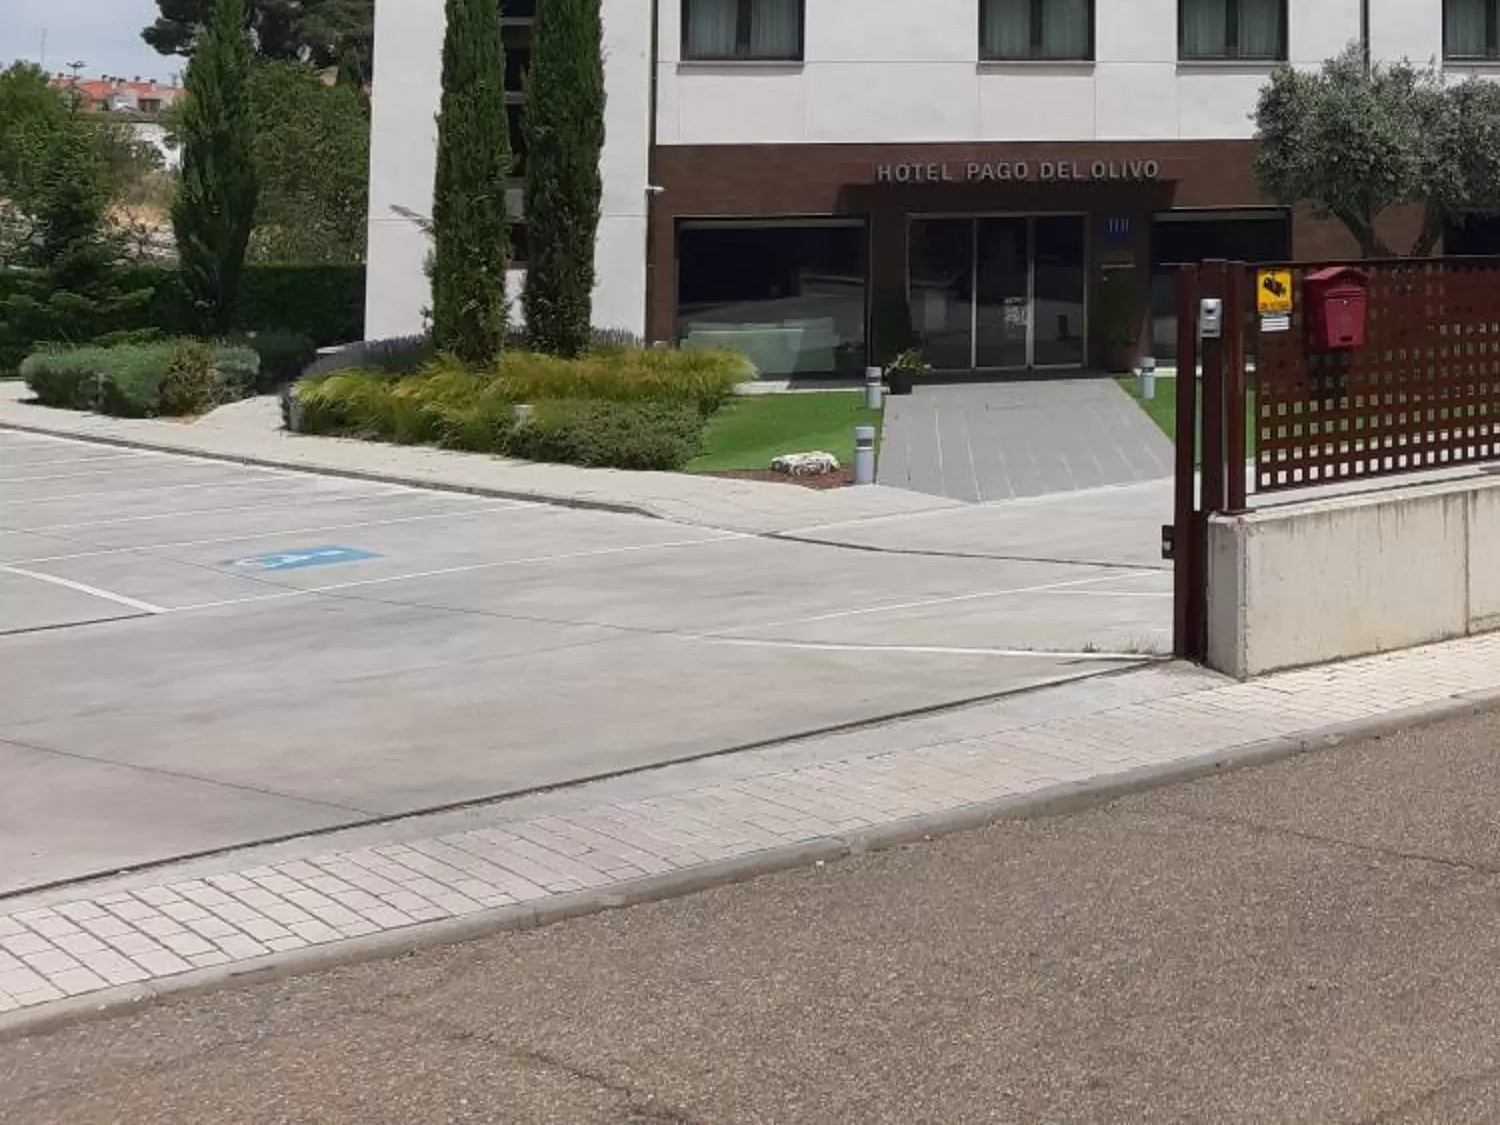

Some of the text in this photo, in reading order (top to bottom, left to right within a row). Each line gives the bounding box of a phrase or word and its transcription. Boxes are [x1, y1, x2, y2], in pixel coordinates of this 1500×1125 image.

[876, 159, 1159, 182] HOTEL PAGO DEL OLIVO
